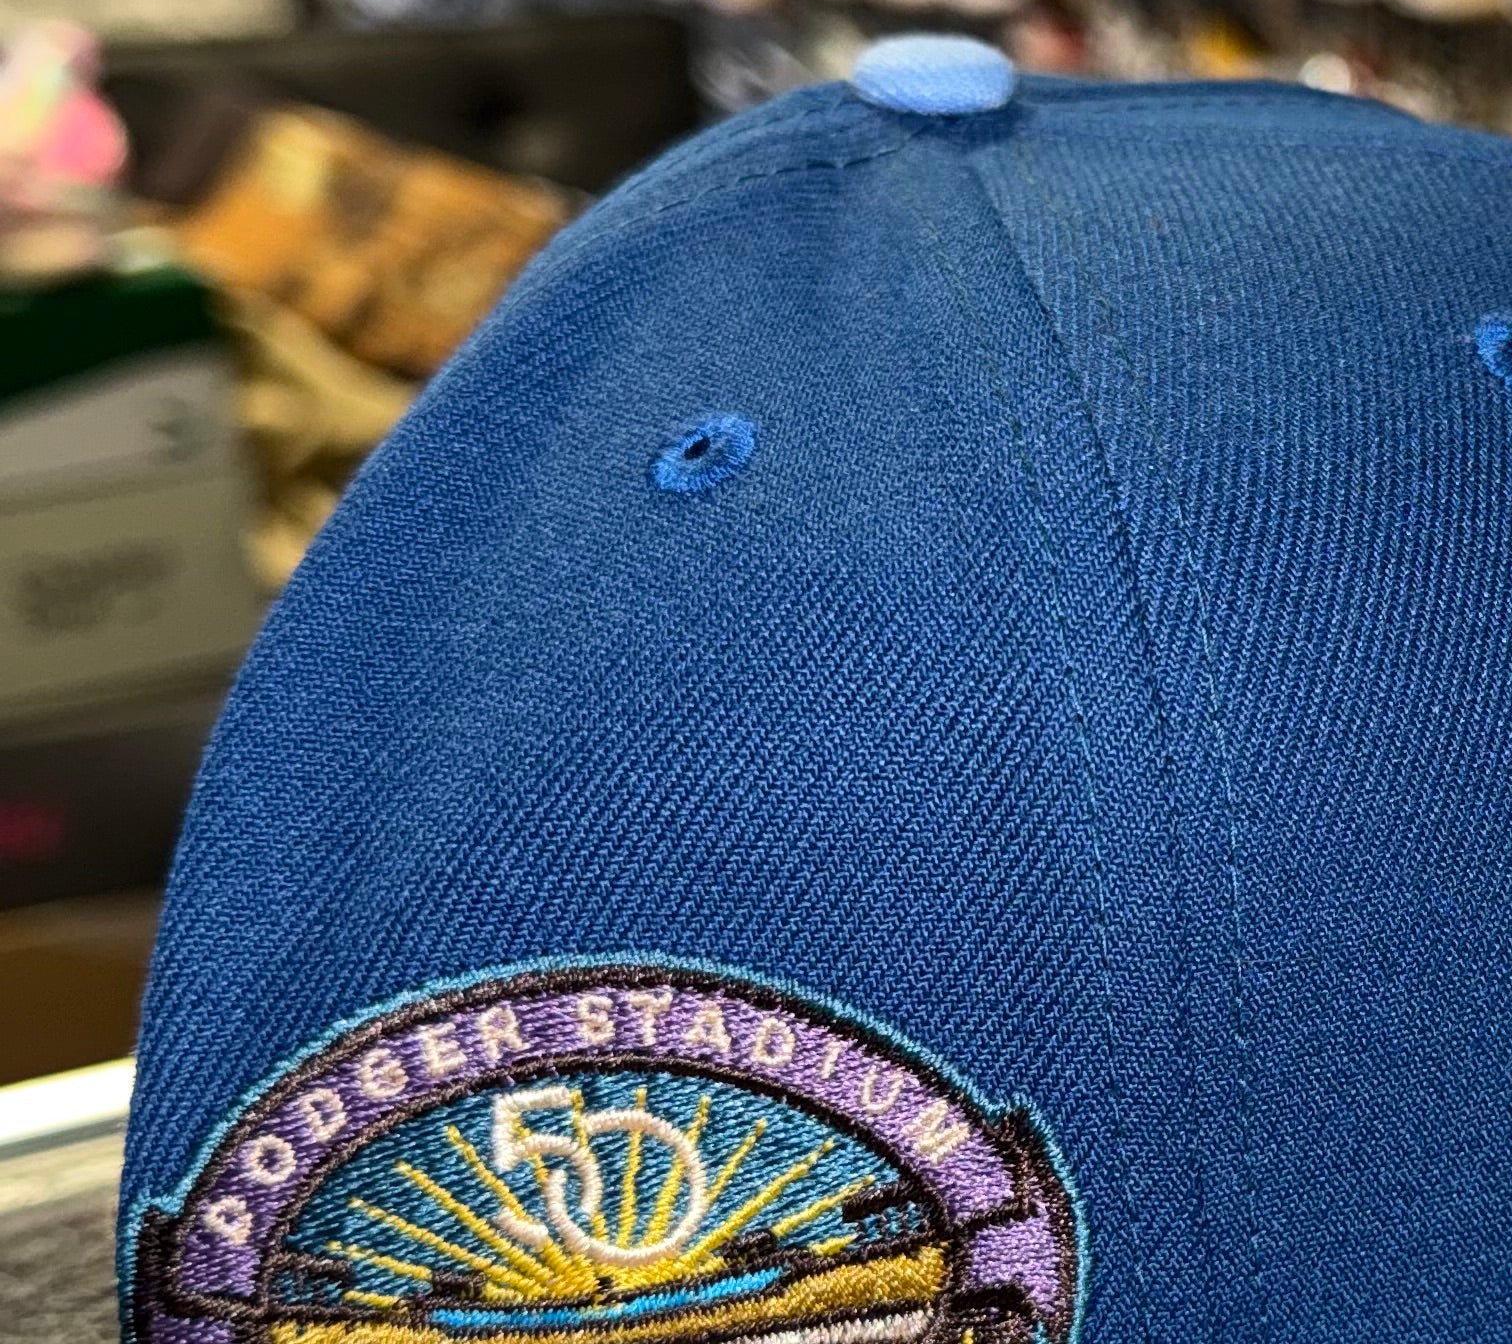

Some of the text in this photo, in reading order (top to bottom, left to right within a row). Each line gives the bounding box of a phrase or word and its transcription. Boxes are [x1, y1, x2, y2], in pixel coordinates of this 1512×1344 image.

[200, 986, 974, 1244] DODGER STADIUM
[493, 1086, 706, 1268] 50
